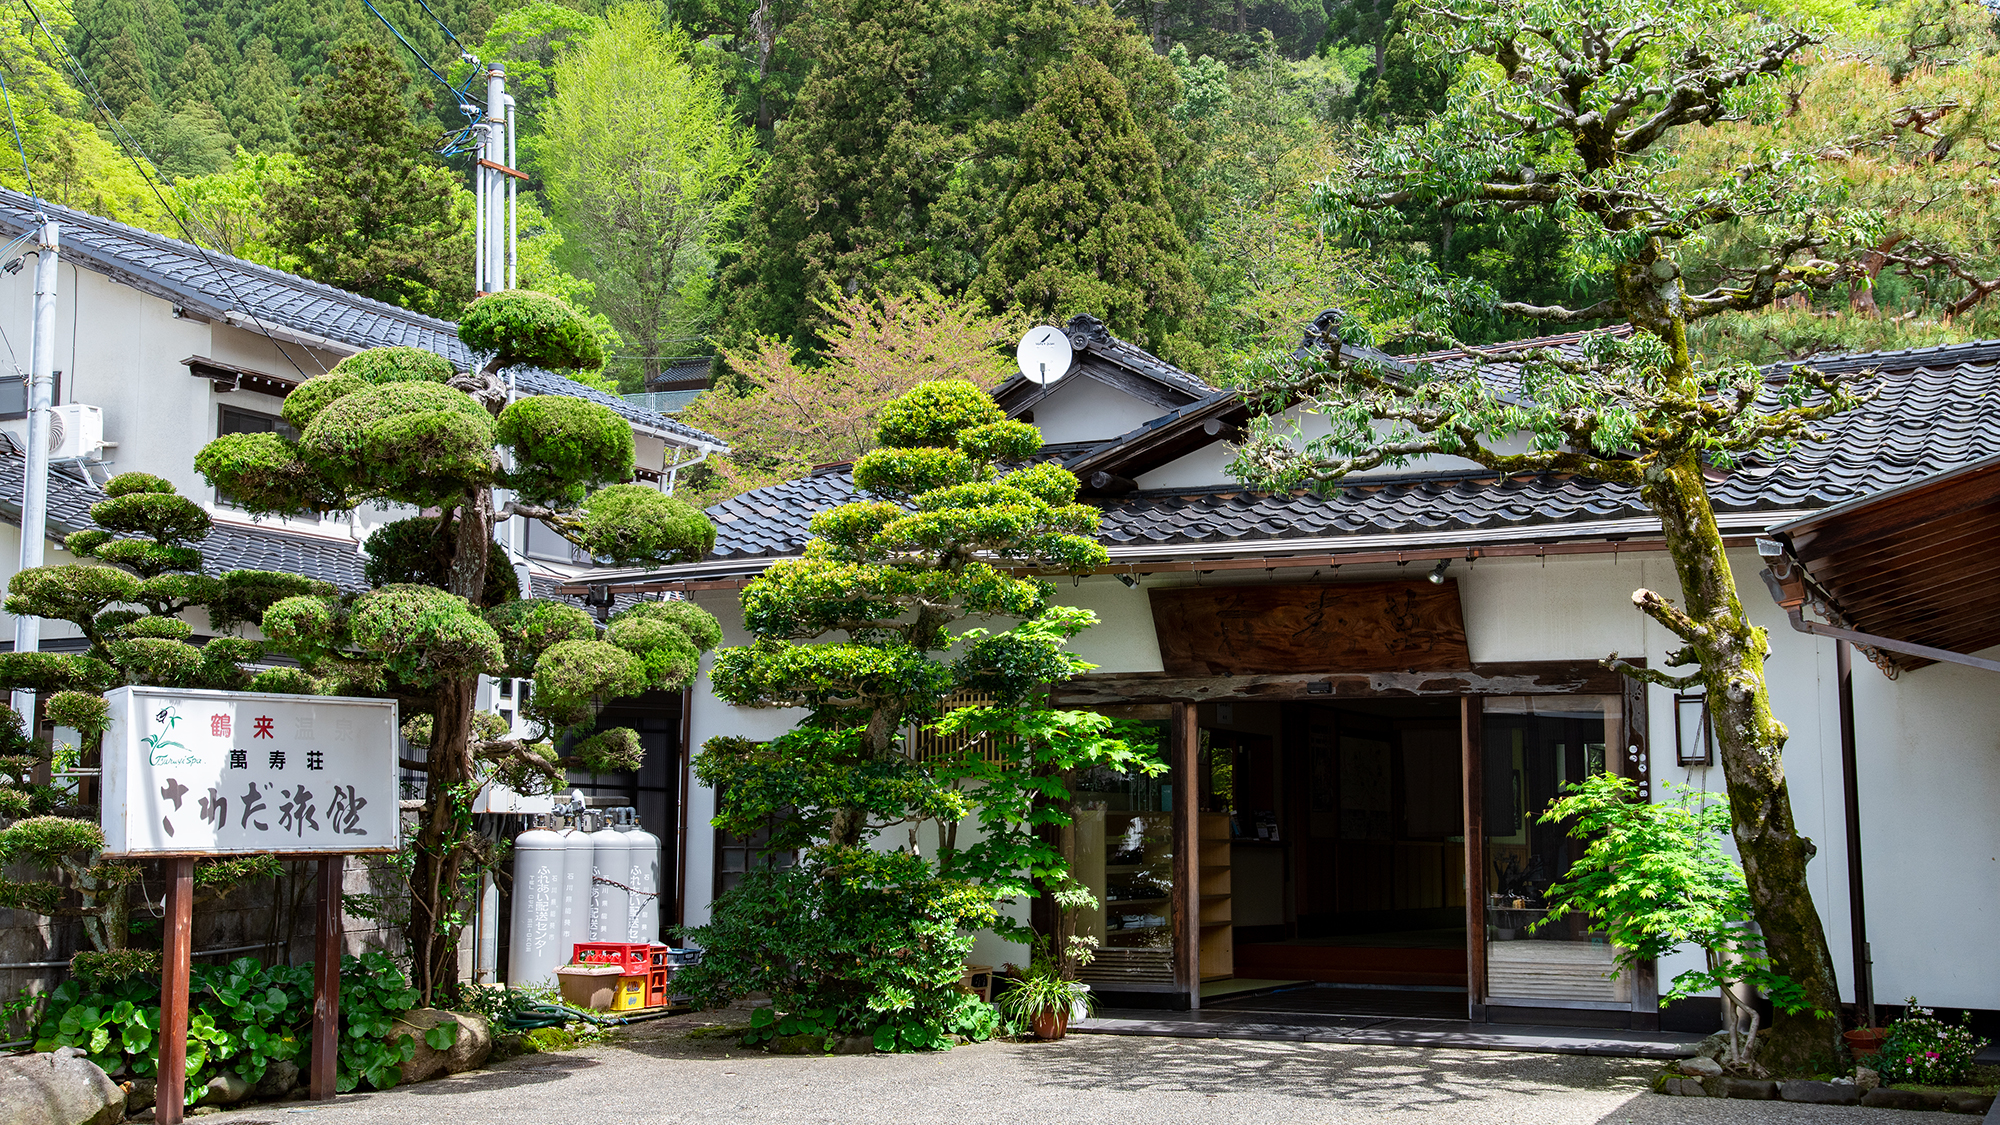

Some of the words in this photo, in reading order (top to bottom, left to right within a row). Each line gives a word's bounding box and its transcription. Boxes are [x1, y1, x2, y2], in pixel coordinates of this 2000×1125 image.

[229, 749, 324, 771] 萬寿荘
[534, 865, 551, 957] ふれあい配送センター
